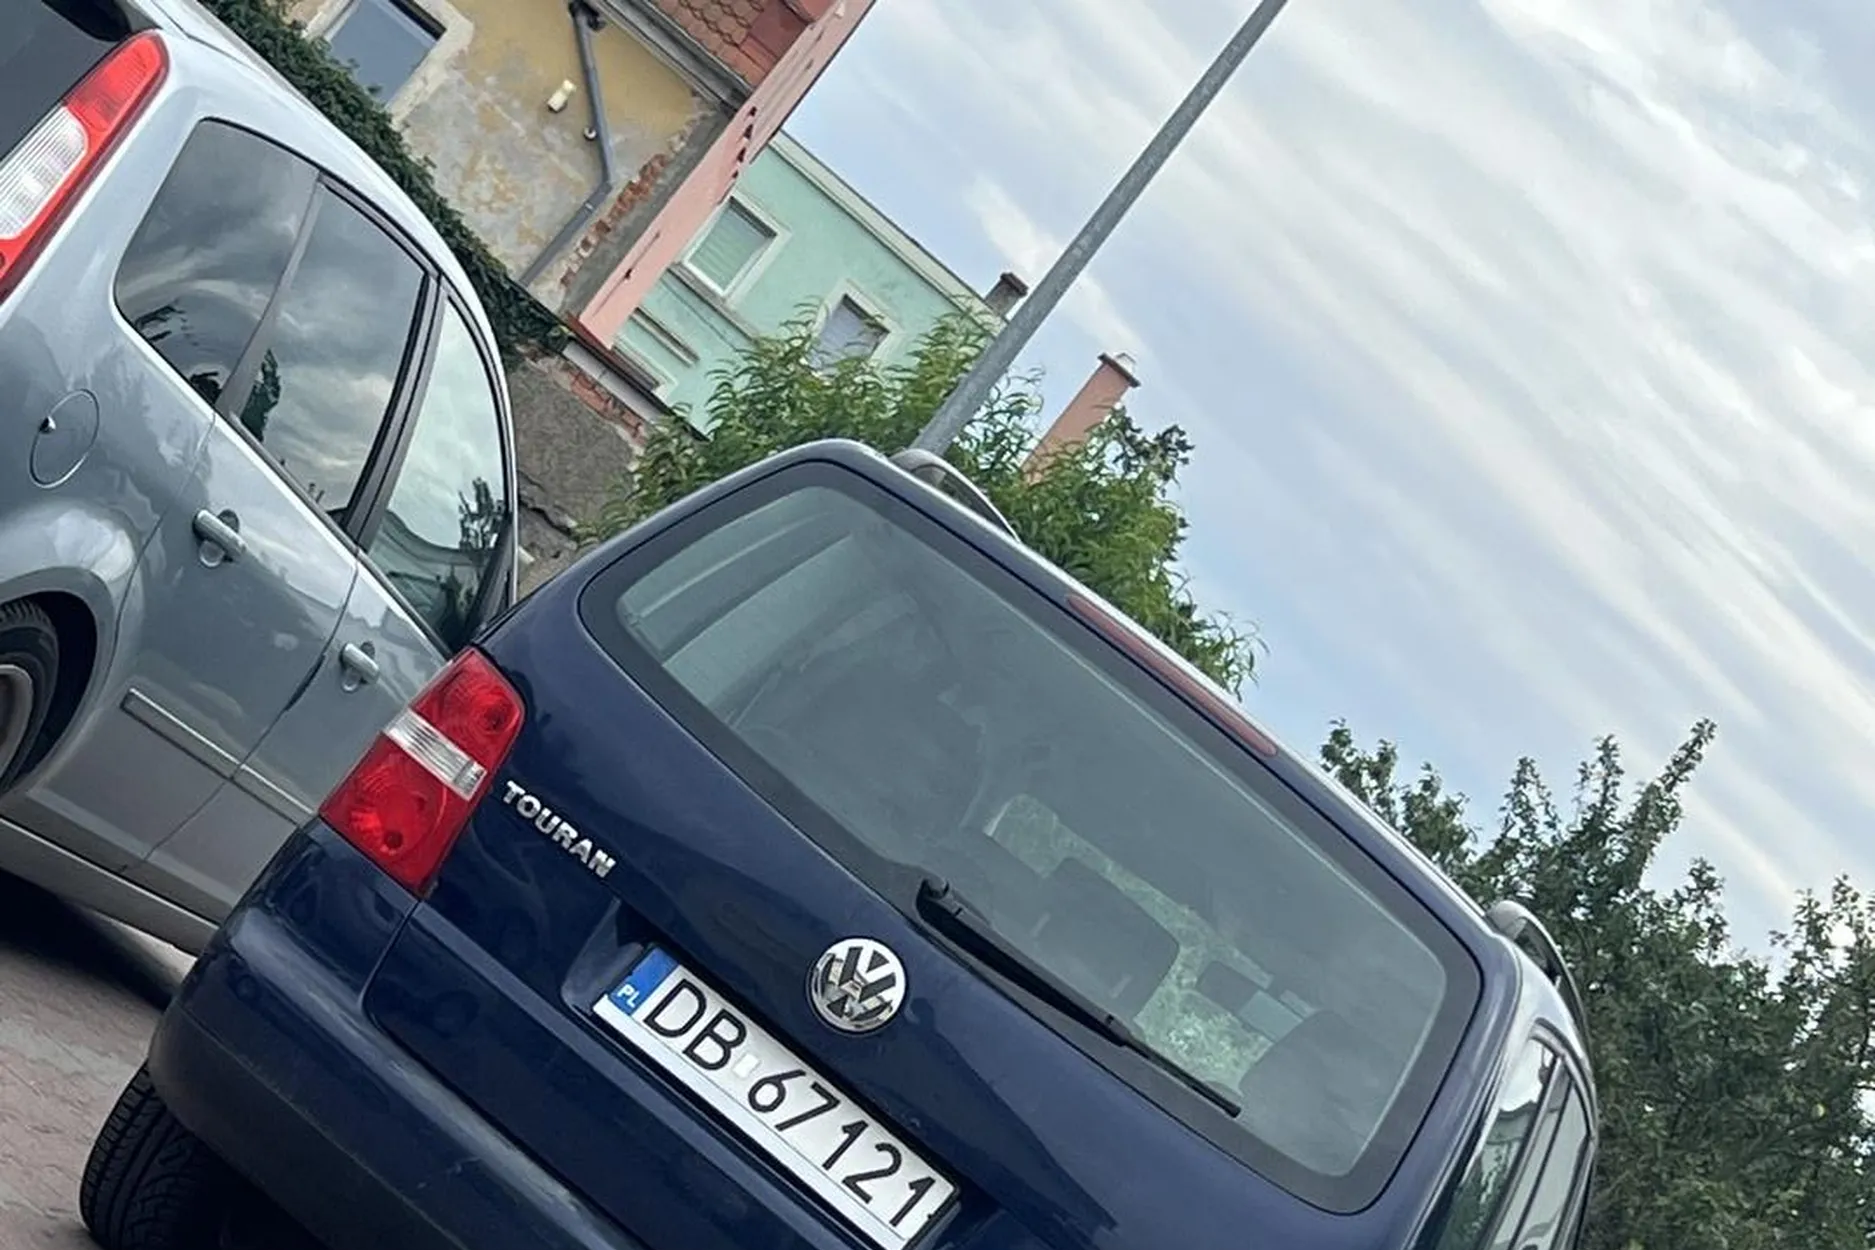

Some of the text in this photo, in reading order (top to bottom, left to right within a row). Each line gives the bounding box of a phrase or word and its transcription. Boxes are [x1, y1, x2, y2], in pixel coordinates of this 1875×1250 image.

[503, 780, 616, 878] TOURAN
[616, 984, 640, 1008] PL
[643, 978, 936, 1227] DB 67121
